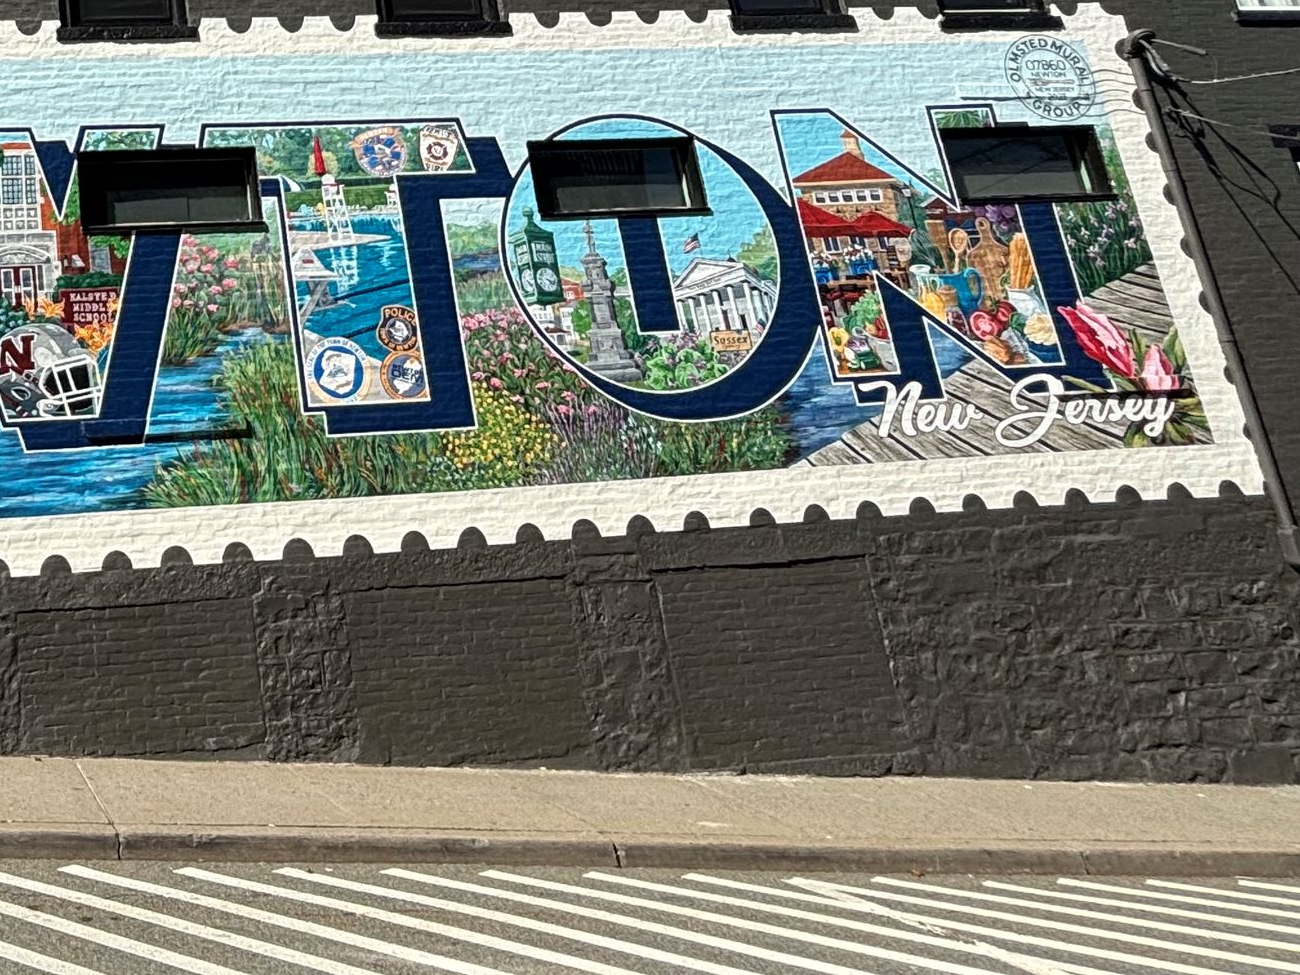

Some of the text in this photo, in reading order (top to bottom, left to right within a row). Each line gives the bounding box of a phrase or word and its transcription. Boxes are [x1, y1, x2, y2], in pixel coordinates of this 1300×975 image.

[1009, 38, 1090, 83] OLMSTED MURAL
[1025, 59, 1067, 71] 07860
[1032, 99, 1081, 118] GROUP
[73, 312, 115, 323] SCHOOL
[713, 335, 749, 345] Sussex
[857, 373, 1175, 448] New Jersey
